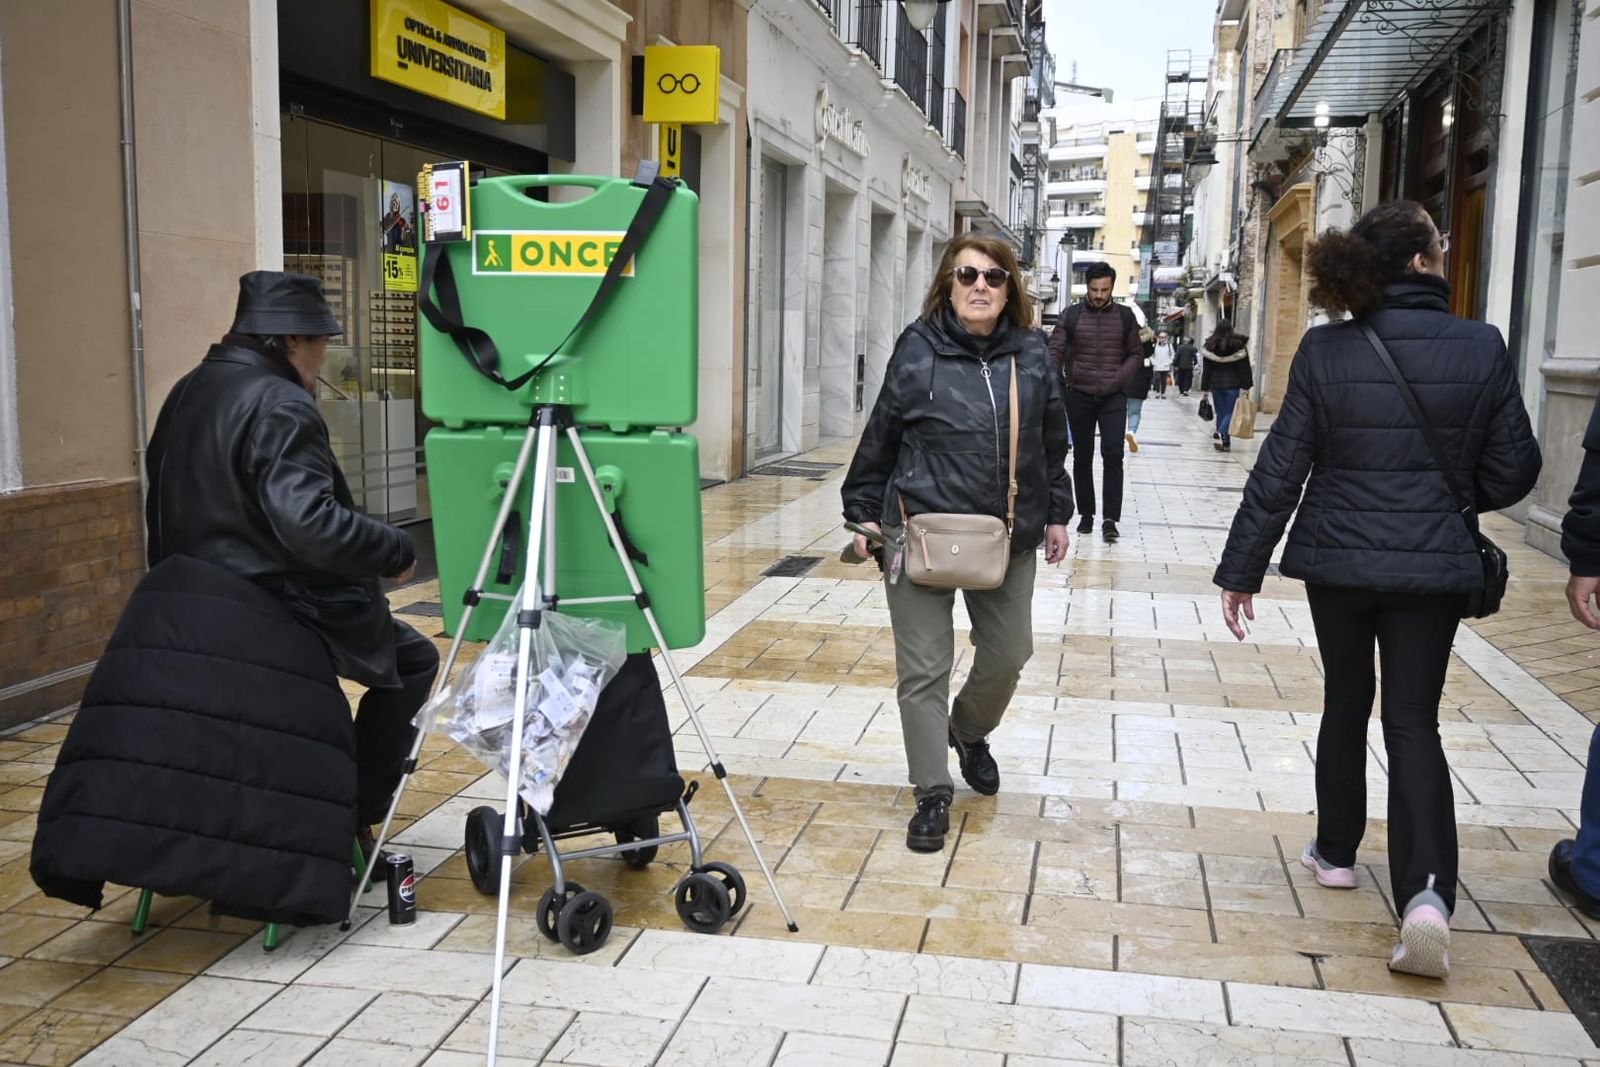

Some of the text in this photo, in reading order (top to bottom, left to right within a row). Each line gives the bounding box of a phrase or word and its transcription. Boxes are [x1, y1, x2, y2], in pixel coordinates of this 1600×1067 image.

[436, 30, 443, 43] &
[396, 35, 492, 92] UNIVERSITARIA
[519, 240, 622, 268] ONCE
